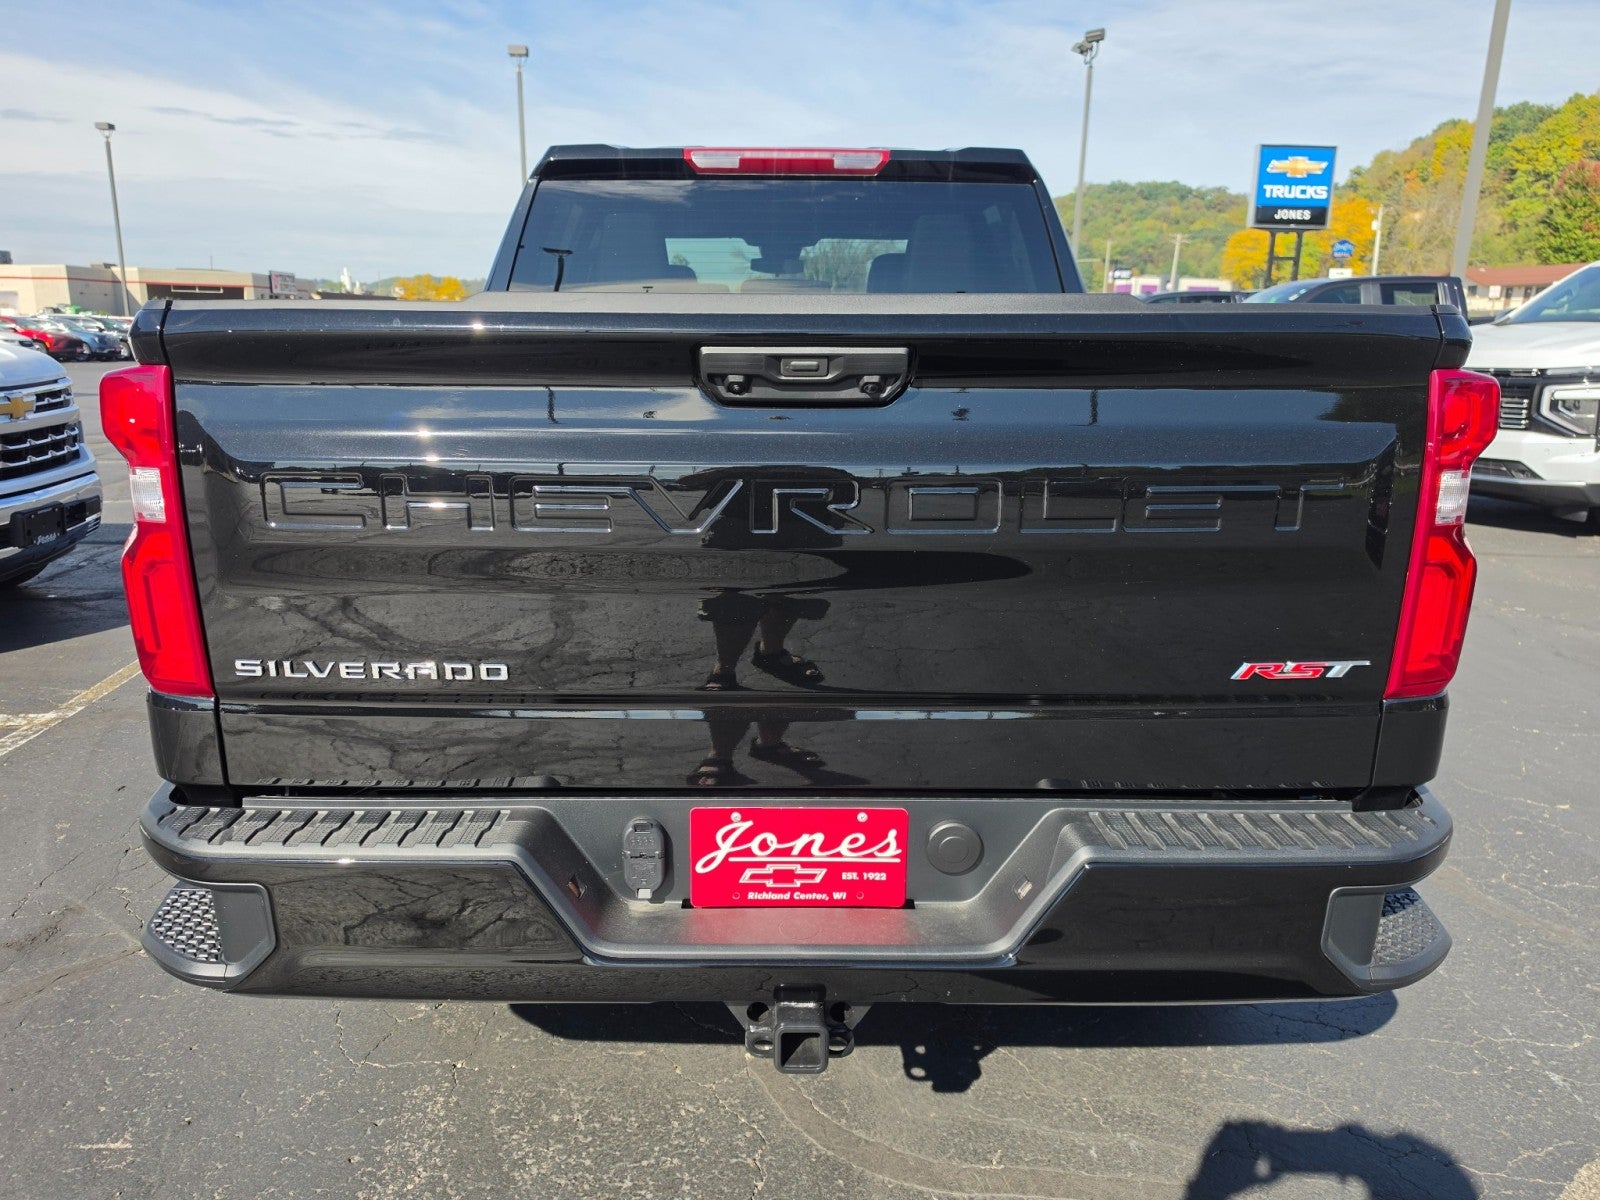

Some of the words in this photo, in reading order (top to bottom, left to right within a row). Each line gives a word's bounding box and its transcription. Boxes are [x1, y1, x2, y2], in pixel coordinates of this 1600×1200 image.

[1263, 184, 1328, 199] TRUCKS
[1274, 209, 1311, 220] JONES
[260, 472, 1345, 534] CHEVROLET
[234, 659, 509, 681] SILVERADO
[1230, 660, 1371, 680] RST
[695, 820, 902, 873] Jones
[842, 872, 859, 880] EST.
[863, 872, 886, 881] 1922
[748, 892, 790, 900] Richland
[793, 892, 829, 901] Center,
[833, 892, 847, 900] WI
